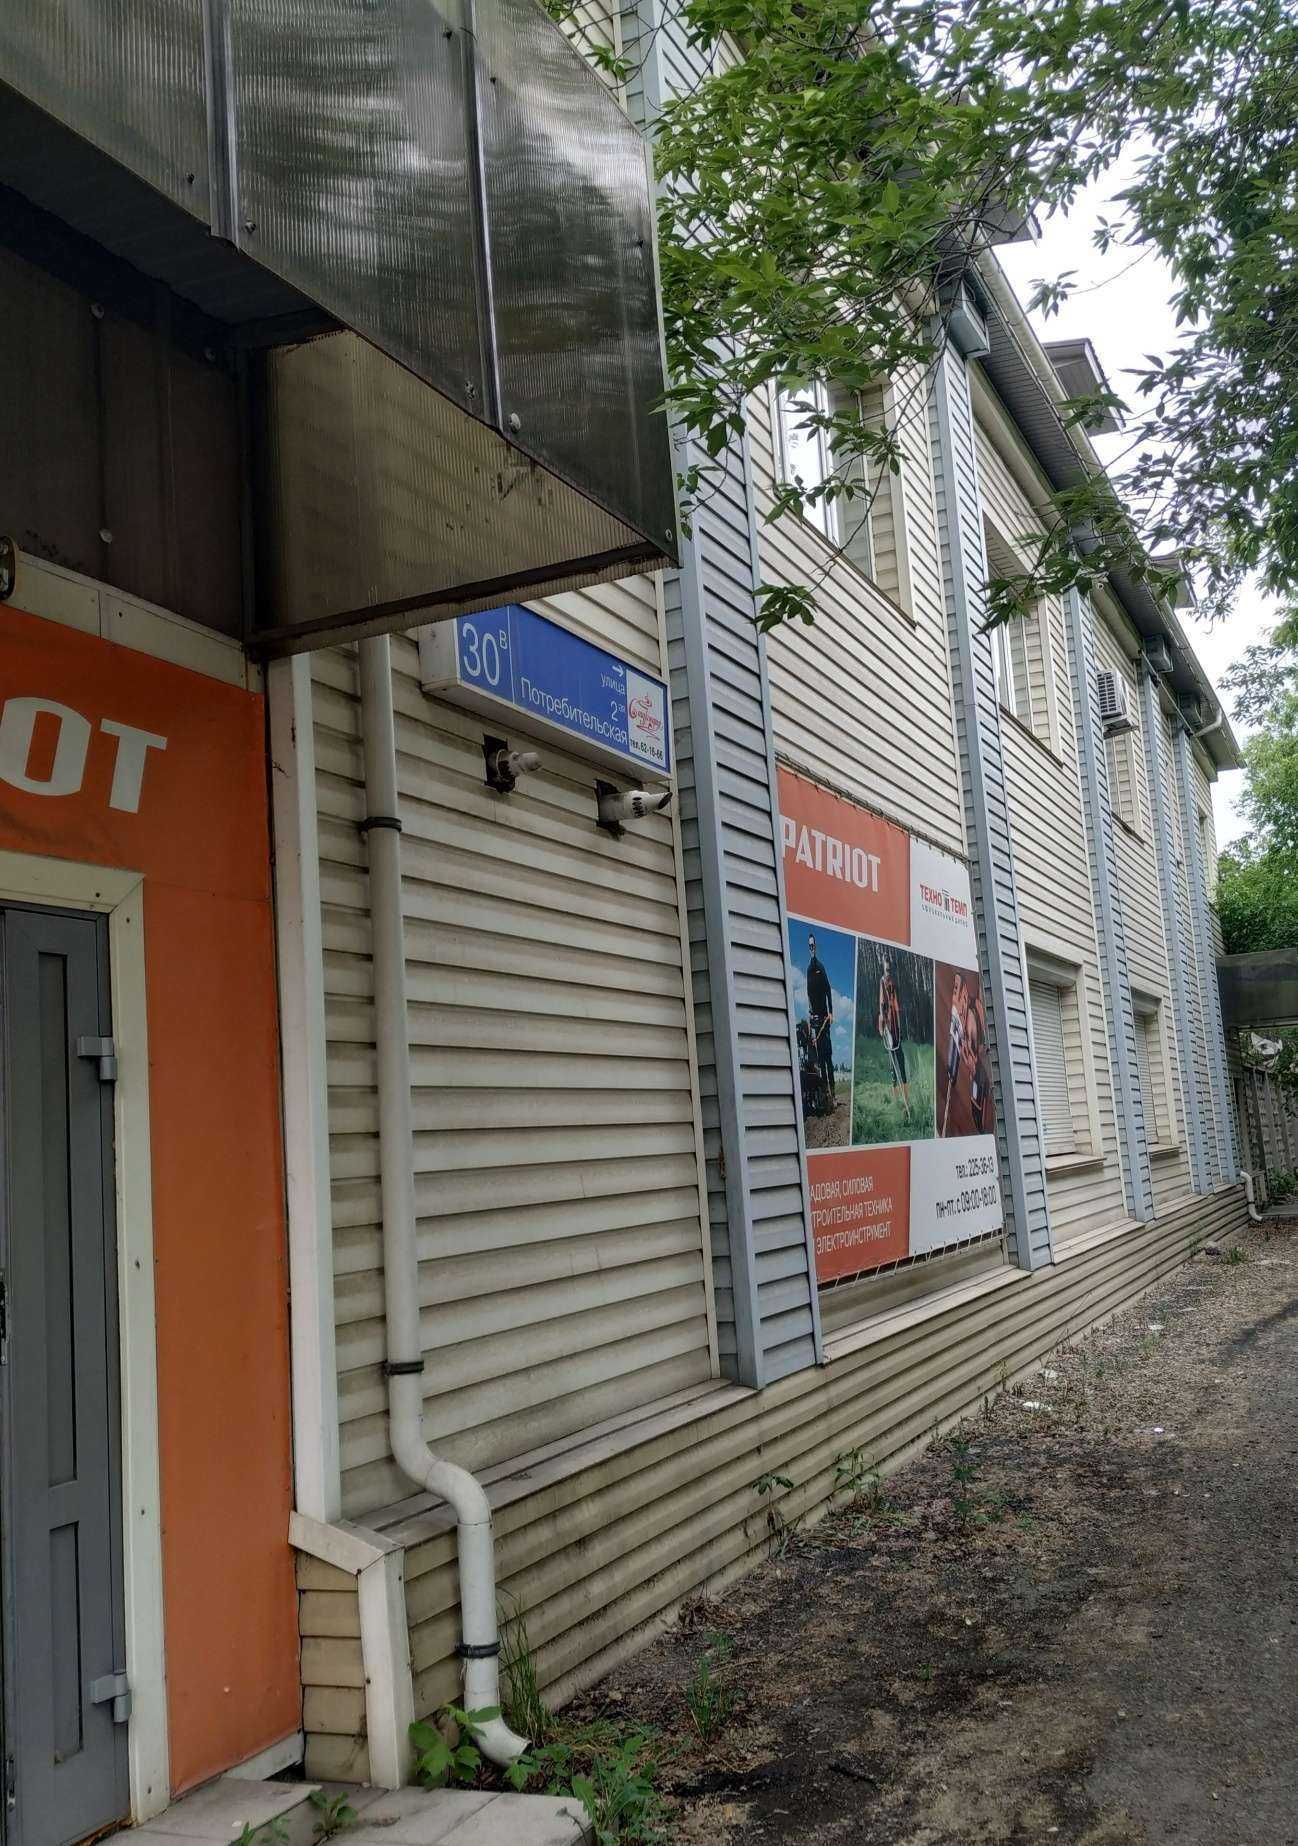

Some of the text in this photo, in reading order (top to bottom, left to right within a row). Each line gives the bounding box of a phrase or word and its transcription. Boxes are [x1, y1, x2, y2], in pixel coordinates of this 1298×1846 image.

[601, 673, 626, 696] улица
[521, 676, 628, 745] Потребительская
[779, 814, 881, 893] PATRIOT
[920, 884, 943, 907] ТЕХНО
[811, 1176, 874, 1203] АДОВАЯ, СИЛОВАЯ
[811, 1197, 893, 1229] ТРОИТЕЛЬНАЯ ТЕХНИКА
[816, 1221, 893, 1255] ЭЛЕКТРОИНСТРУМЕНТ
